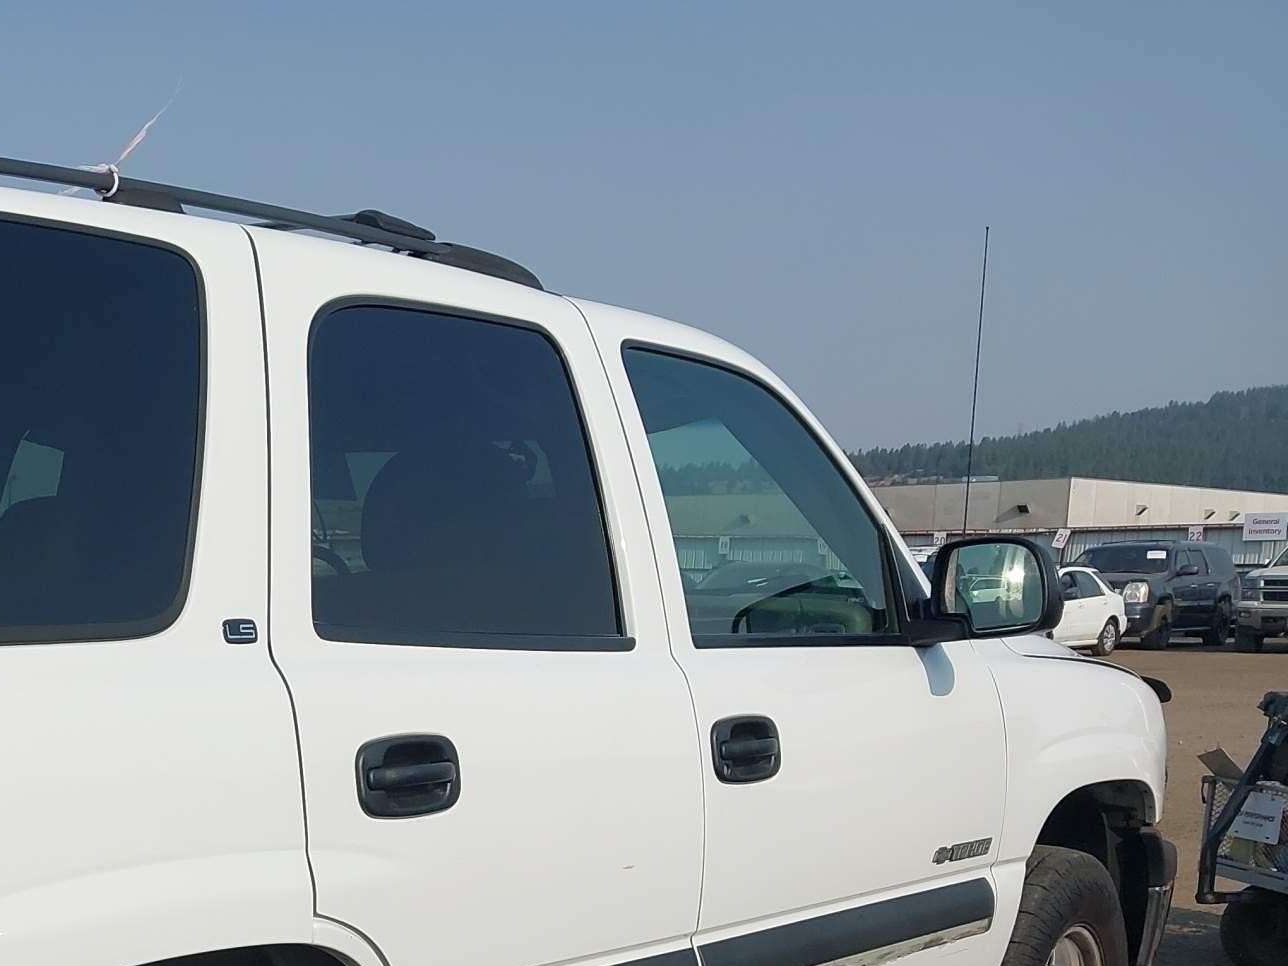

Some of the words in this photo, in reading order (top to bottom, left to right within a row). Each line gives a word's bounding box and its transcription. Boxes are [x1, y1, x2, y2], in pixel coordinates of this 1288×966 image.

[934, 536, 946, 545] 20
[1055, 533, 1068, 544] 21
[1189, 531, 1202, 541] 22
[225, 623, 256, 639] LS
